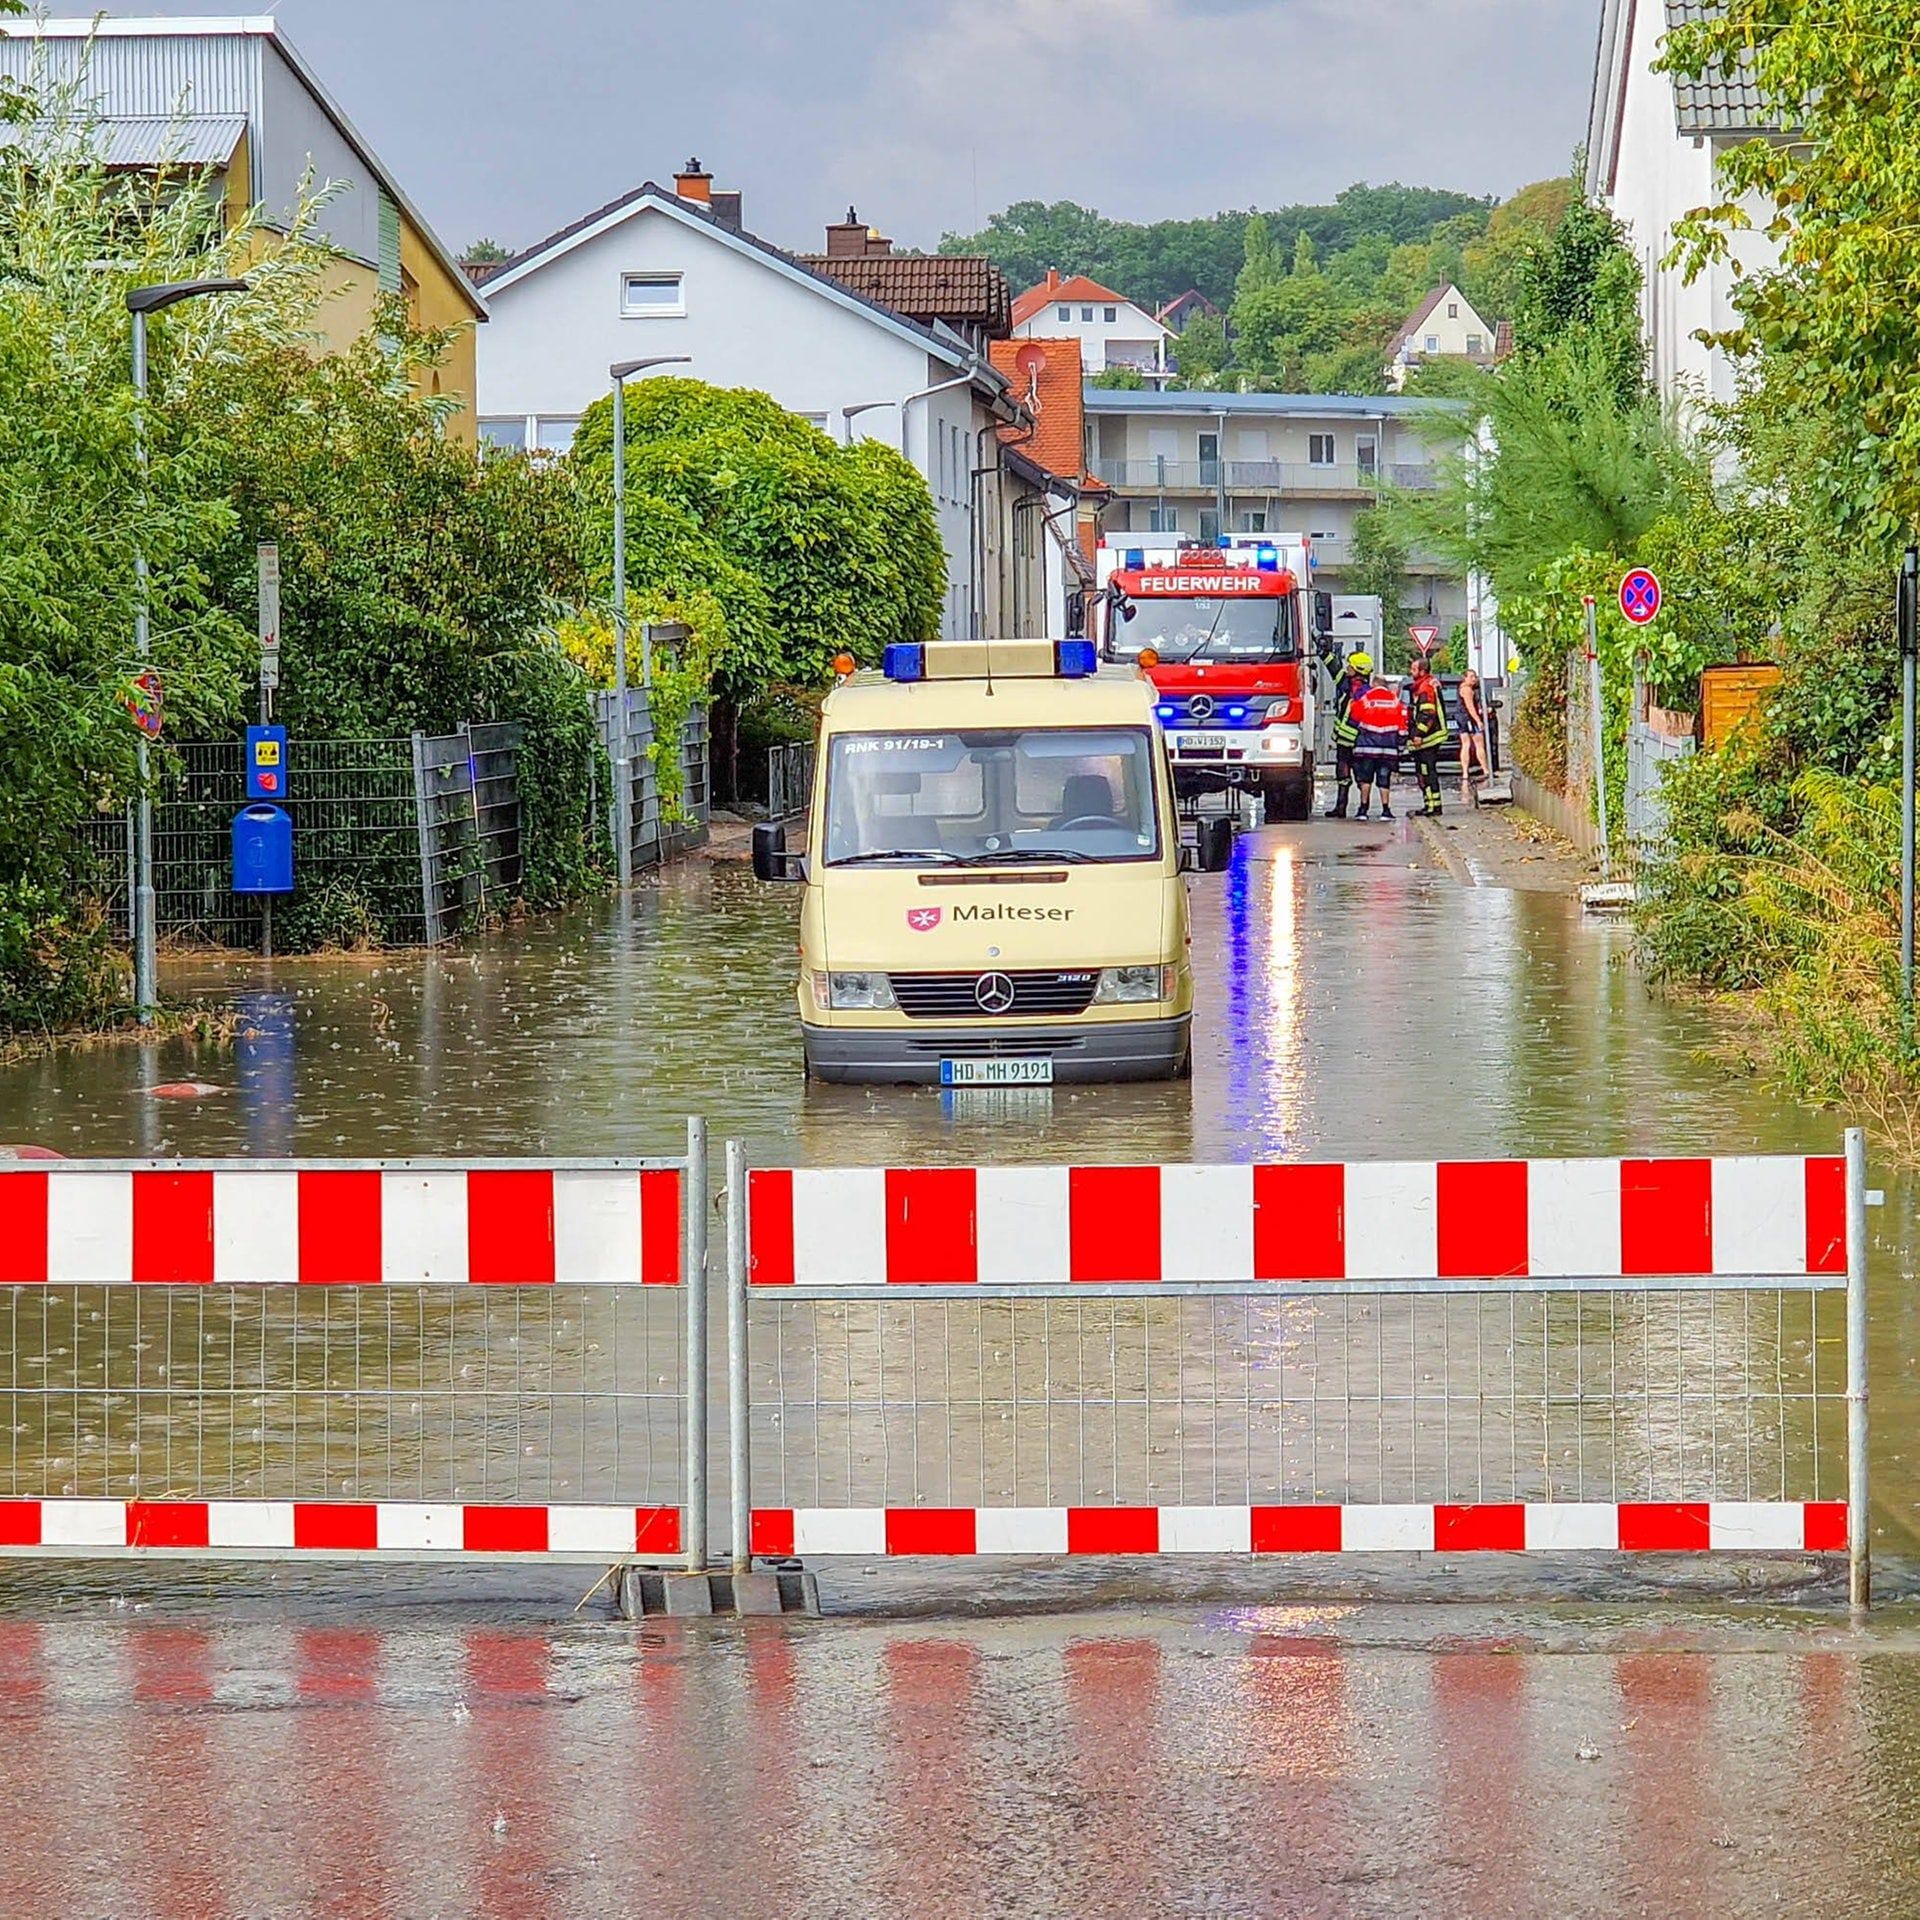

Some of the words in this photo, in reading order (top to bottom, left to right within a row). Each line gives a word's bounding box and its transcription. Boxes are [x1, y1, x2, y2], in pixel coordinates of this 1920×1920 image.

[1140, 576, 1261, 592] FEUERWEHR
[845, 741, 880, 754] RNK
[884, 738, 944, 750] 91/19-1
[953, 904, 1074, 921] Malteser
[954, 1063, 974, 1080] HD
[986, 1063, 1006, 1079] MH
[1011, 1062, 1050, 1079] 9191
